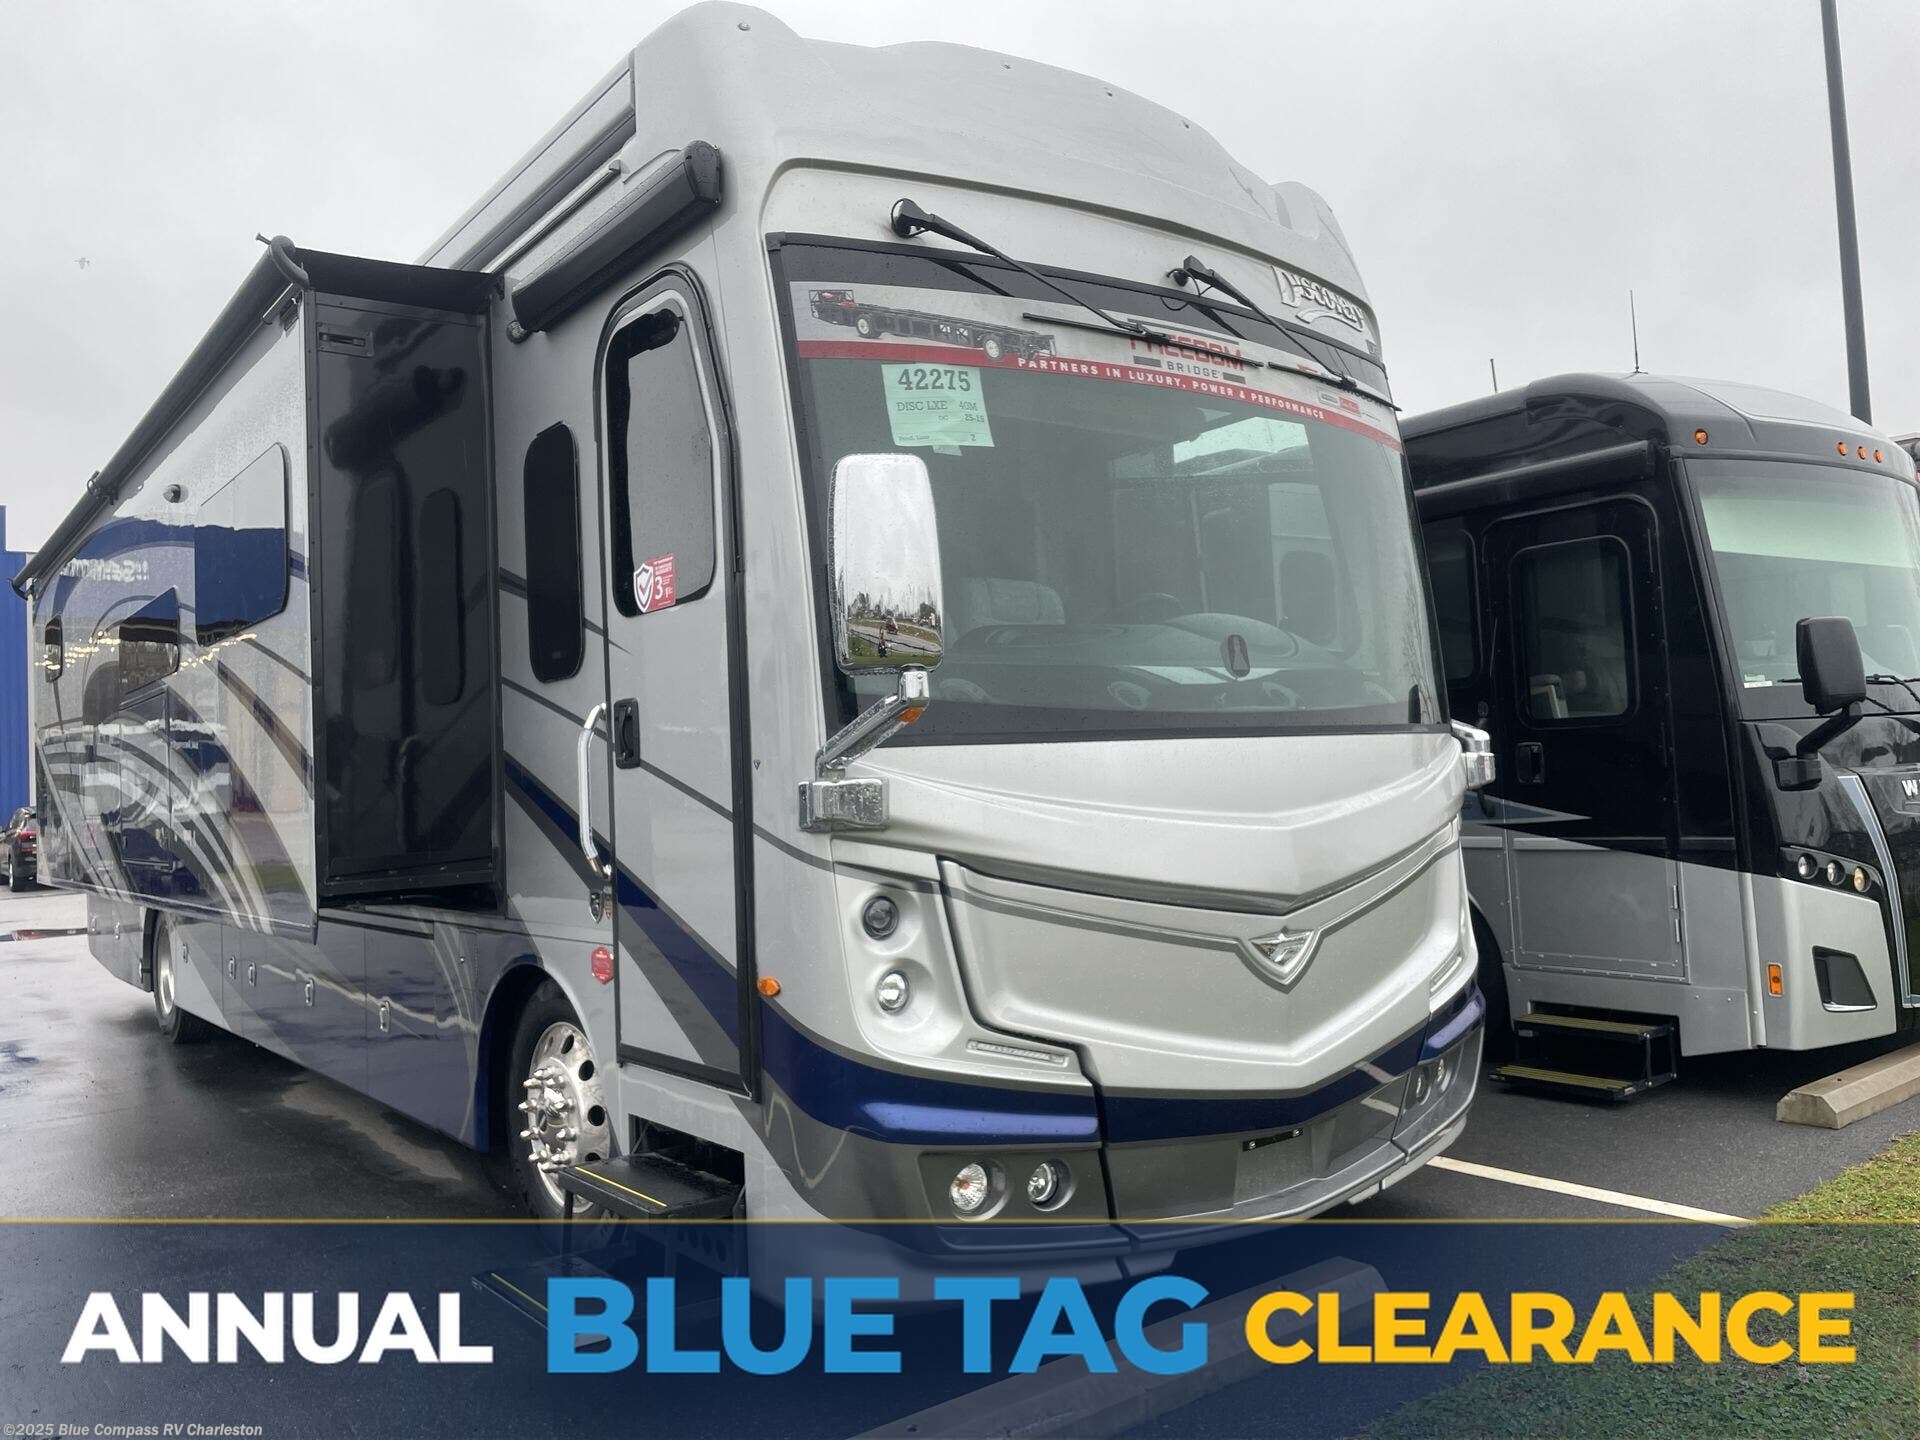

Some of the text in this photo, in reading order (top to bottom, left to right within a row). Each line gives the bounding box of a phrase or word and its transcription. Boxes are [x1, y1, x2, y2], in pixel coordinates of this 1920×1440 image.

[898, 368, 971, 391] 42275
[1167, 360, 1217, 379] BRIDGE
[1018, 357, 1098, 376] PARTNERS
[1106, 367, 1121, 379] IN
[1129, 370, 1186, 389] LUXURY,
[1192, 381, 1234, 398] POWER
[1239, 390, 1246, 399] &
[1252, 393, 1325, 420] PERFORMANCE
[896, 401, 924, 411] DISC
[927, 401, 948, 411] LXE
[655, 576, 663, 600] 3
